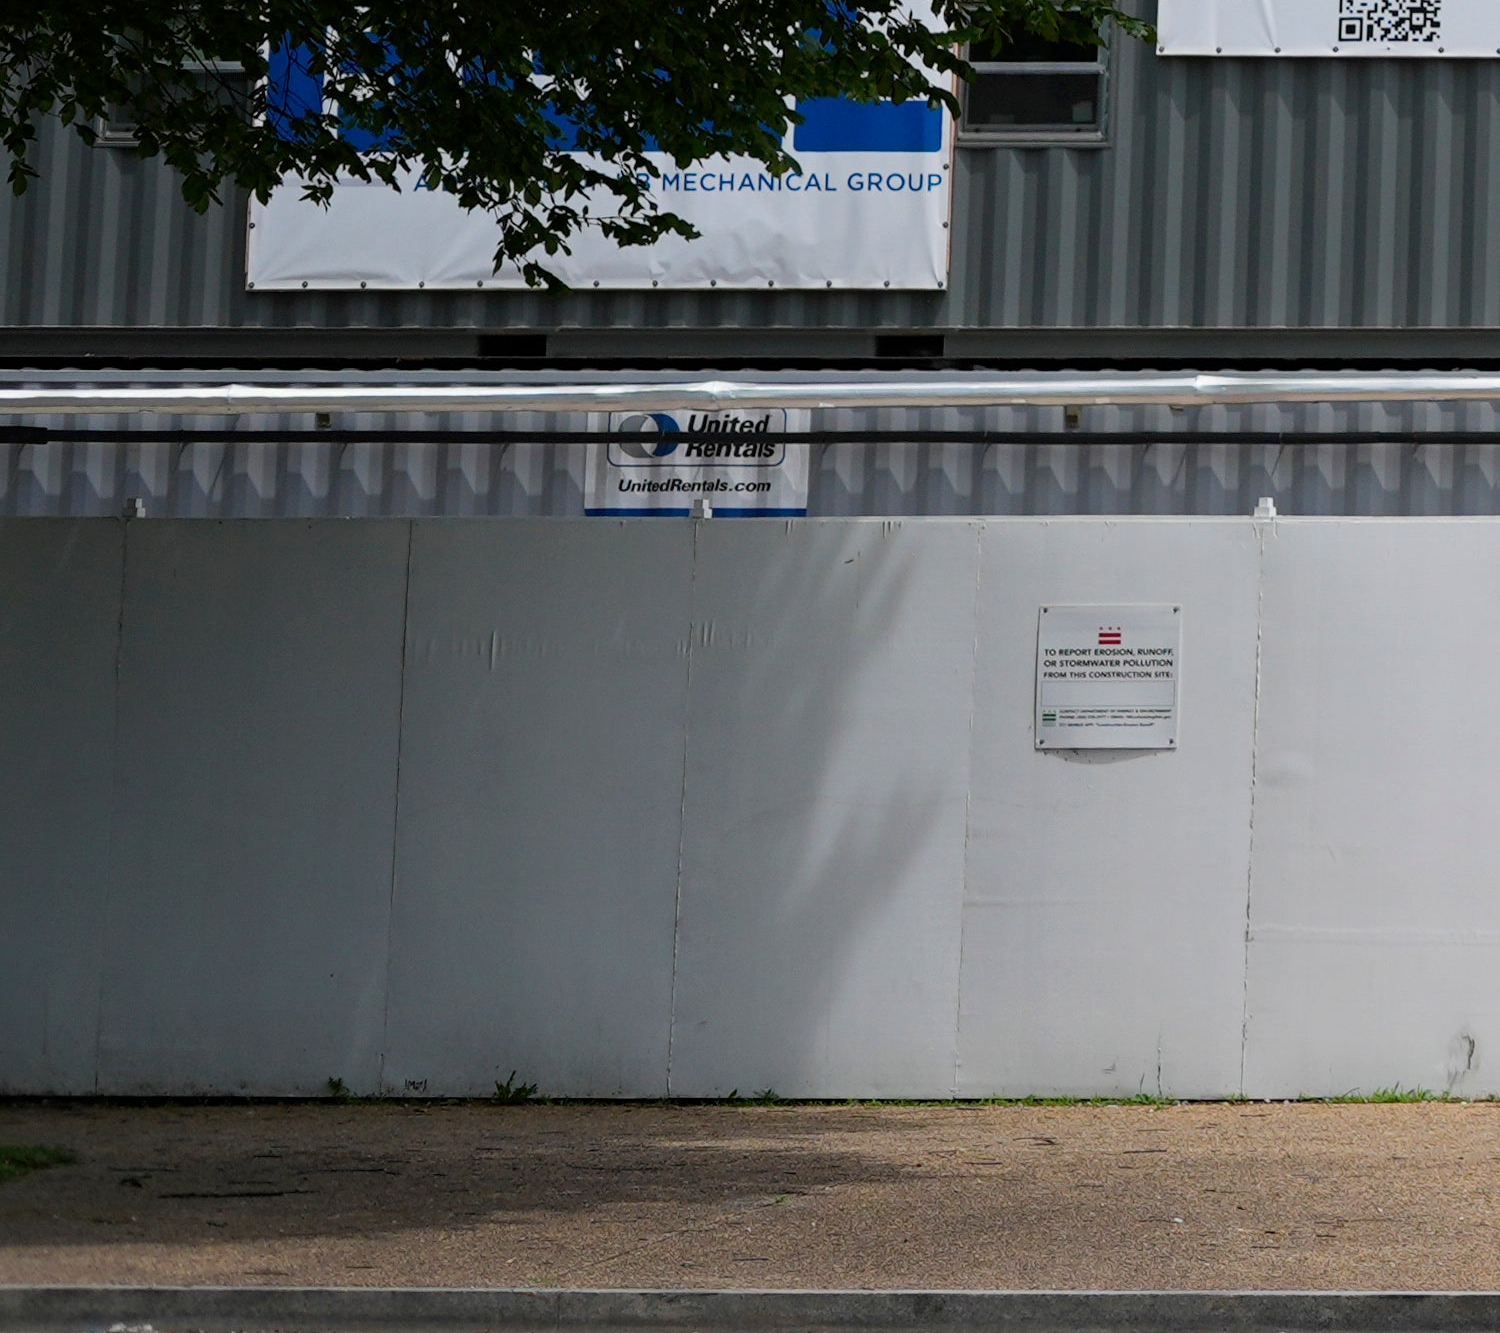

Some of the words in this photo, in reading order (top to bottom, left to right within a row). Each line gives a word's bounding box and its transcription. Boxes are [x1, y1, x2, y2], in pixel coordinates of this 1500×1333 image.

[661, 171, 836, 192] MECHANICAL
[846, 170, 943, 193] GROUP
[687, 413, 770, 433] United
[617, 478, 771, 492] UnitedRentals.com
[1044, 648, 1056, 656] TO
[1058, 648, 1091, 656] REPORT
[1094, 648, 1135, 657] EROSION,
[1137, 648, 1174, 656] RUNOFF,
[1043, 659, 1057, 667] OR
[1059, 659, 1120, 667] STORMWATER
[1123, 659, 1173, 667] POLLUTION
